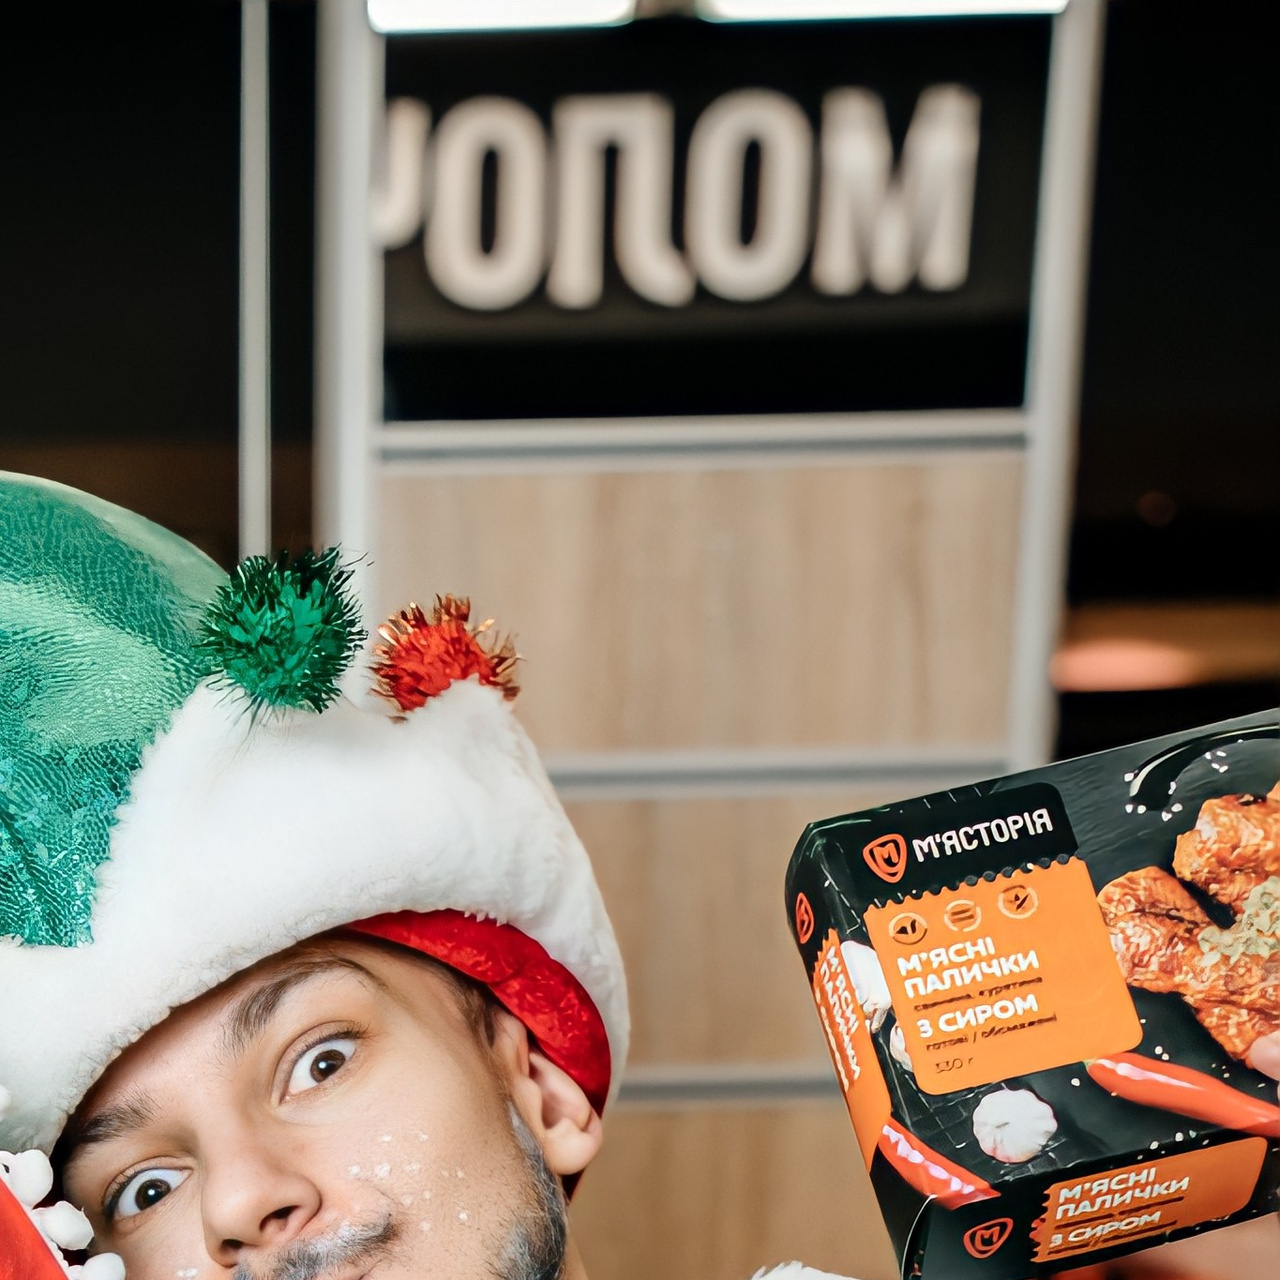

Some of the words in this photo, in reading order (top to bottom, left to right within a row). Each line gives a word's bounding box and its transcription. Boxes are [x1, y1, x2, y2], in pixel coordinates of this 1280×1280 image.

[911, 808, 1054, 862] М'ЯСТОРІЯ
[897, 936, 996, 976] М'ЯСНІ
[904, 950, 1040, 998] ПАЛИЧКИ
[938, 993, 1039, 1033] СИРОМ
[1056, 1176, 1190, 1220] ПАЛИЧКИ
[1058, 1167, 1157, 1203] М'ЯСНІ
[1068, 1211, 1162, 1242] СИРОМ
